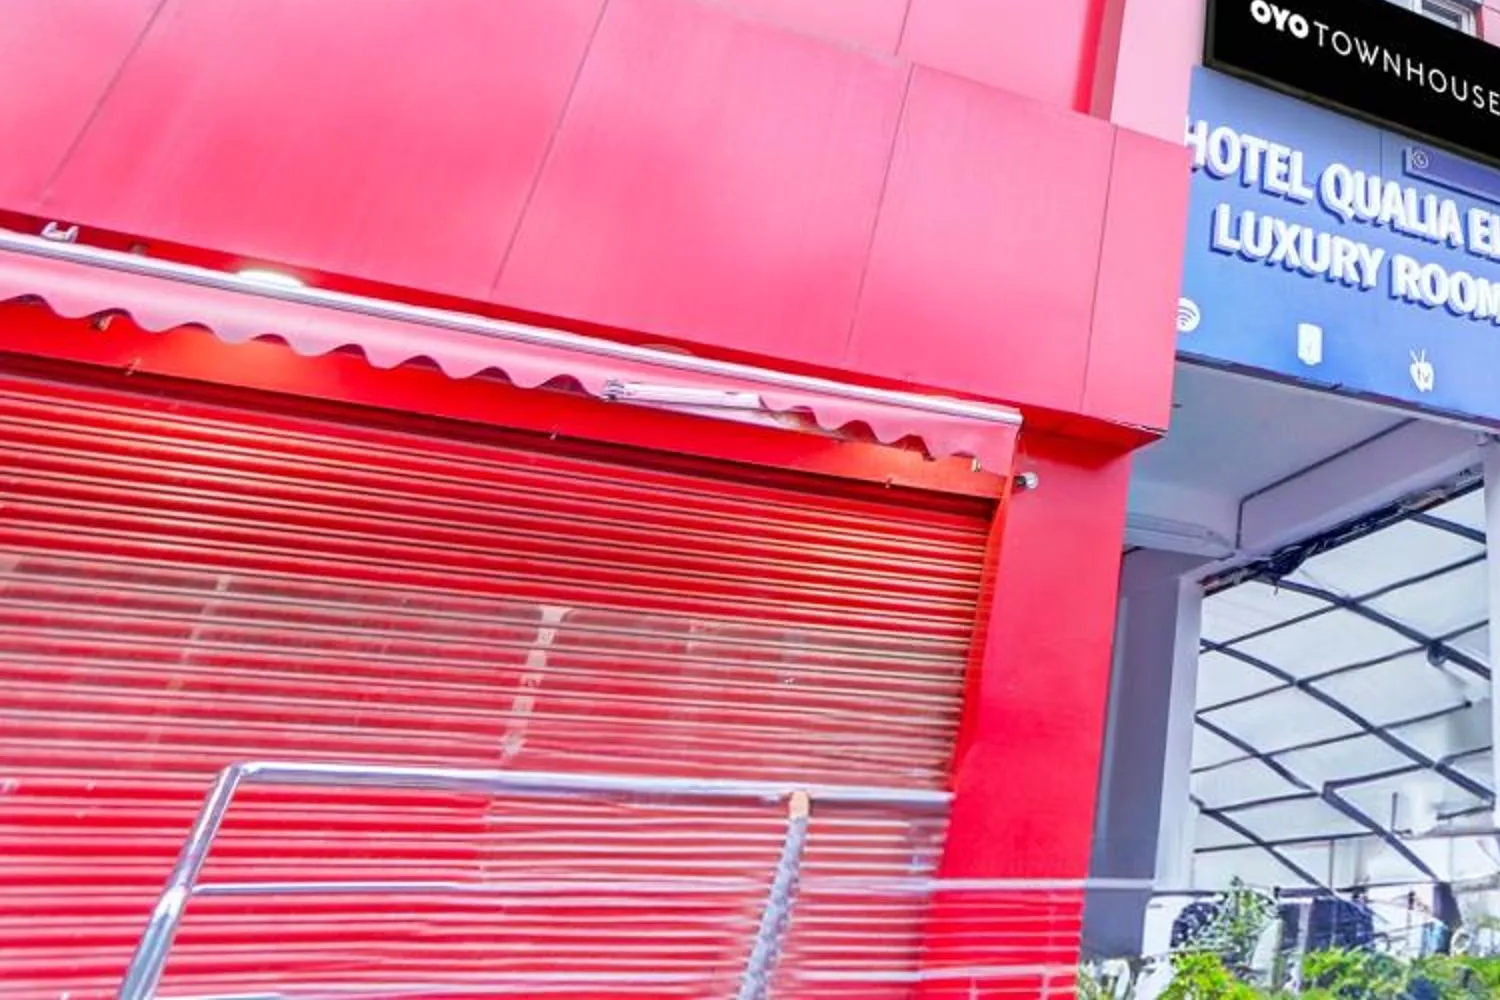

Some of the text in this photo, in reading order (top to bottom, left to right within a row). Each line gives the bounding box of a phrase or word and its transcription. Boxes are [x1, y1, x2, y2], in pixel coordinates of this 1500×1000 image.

[1251, 0, 1310, 39] OYO
[1184, 116, 1313, 203] HOTEL
[1317, 163, 1463, 248] QUALIA
[1210, 203, 1384, 291] LUXURY
